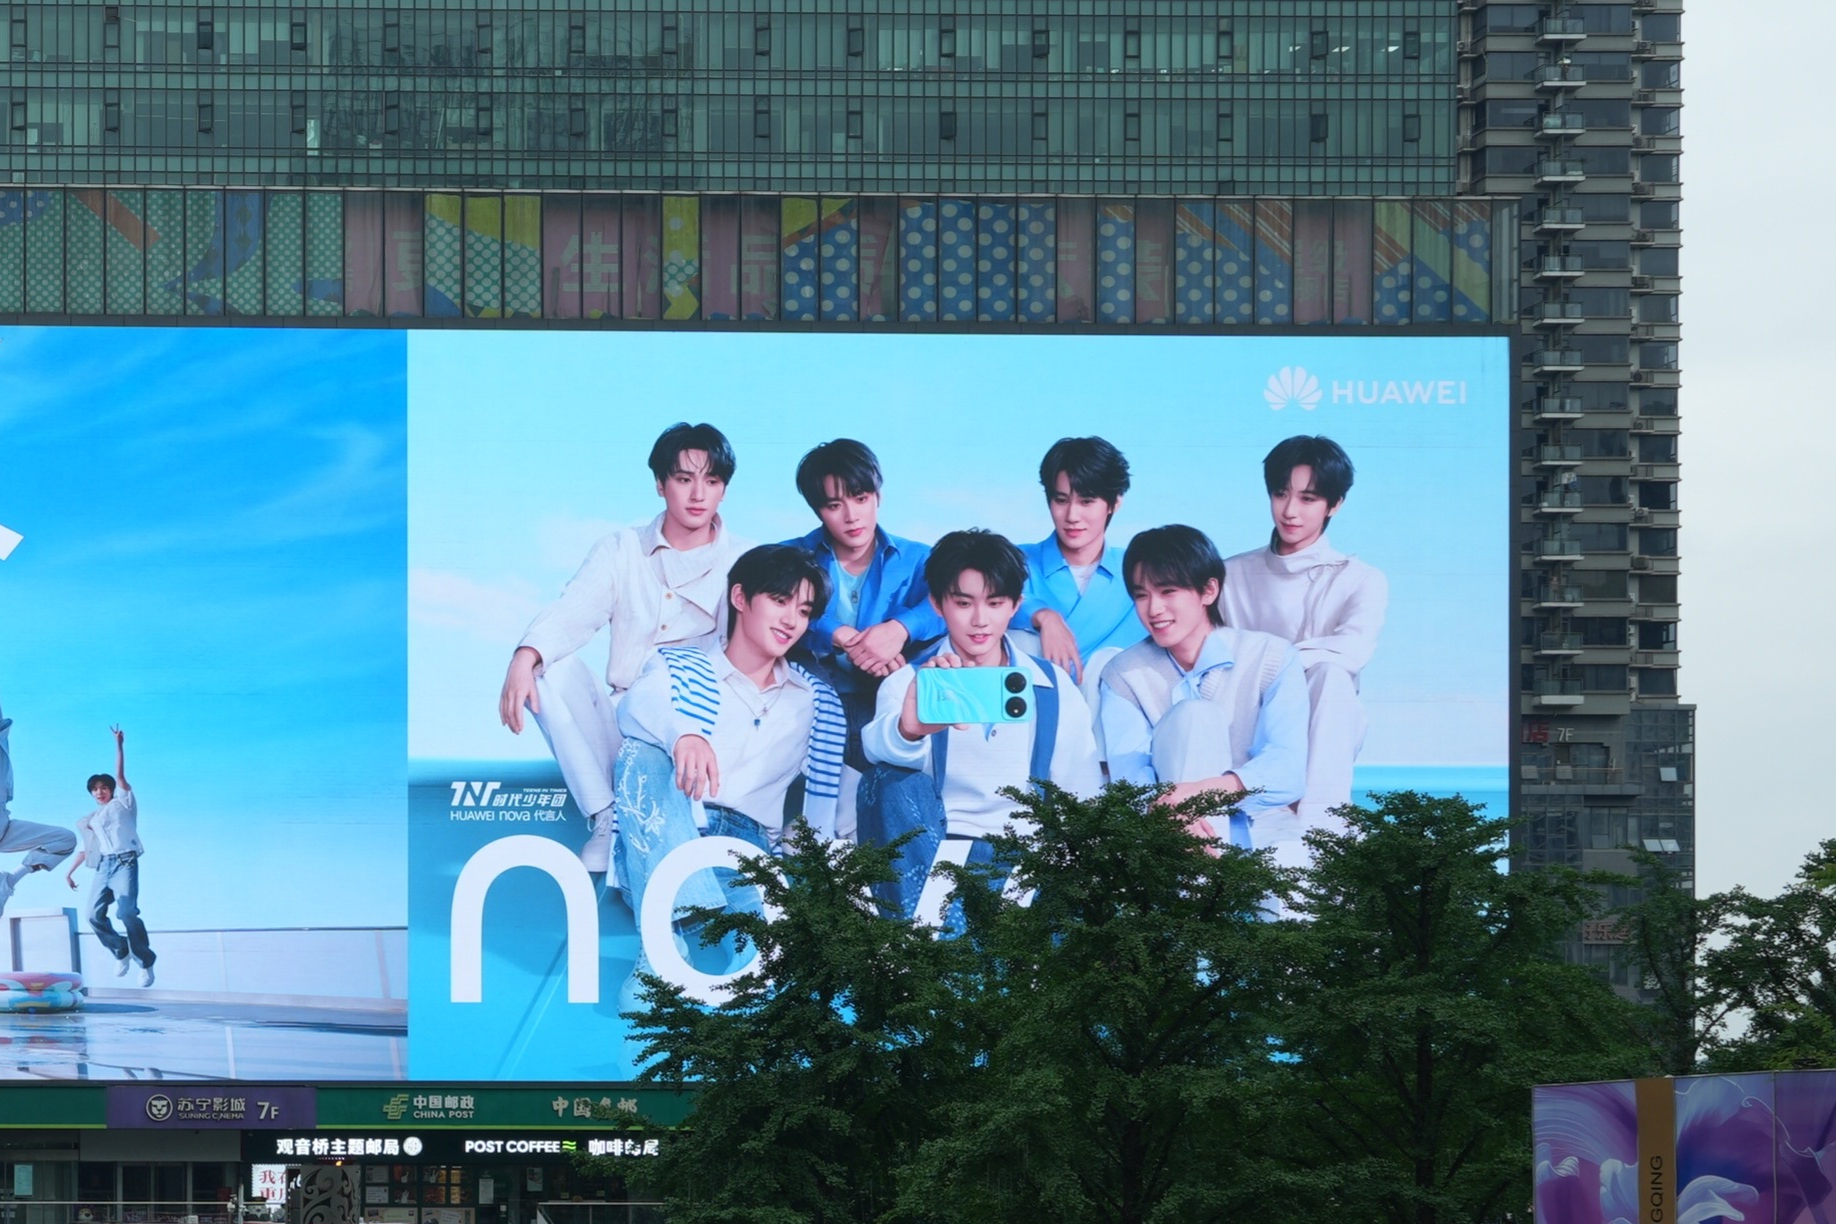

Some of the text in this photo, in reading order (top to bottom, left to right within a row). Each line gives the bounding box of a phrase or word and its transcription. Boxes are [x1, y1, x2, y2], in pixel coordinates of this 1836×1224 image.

[1331, 379, 1468, 404] HUAWEI
[492, 793, 567, 807] 时代少年团
[450, 810, 567, 822] HUAWEI nova 代言人
[177, 1098, 246, 1112] 苏宁影城
[413, 1094, 475, 1110] 中国邮政
[257, 1101, 280, 1120] 7F
[413, 1110, 475, 1119] CHINA POST
[276, 1138, 400, 1156] 观音桥主题邮局
[465, 1140, 561, 1154] POST COFFEE
